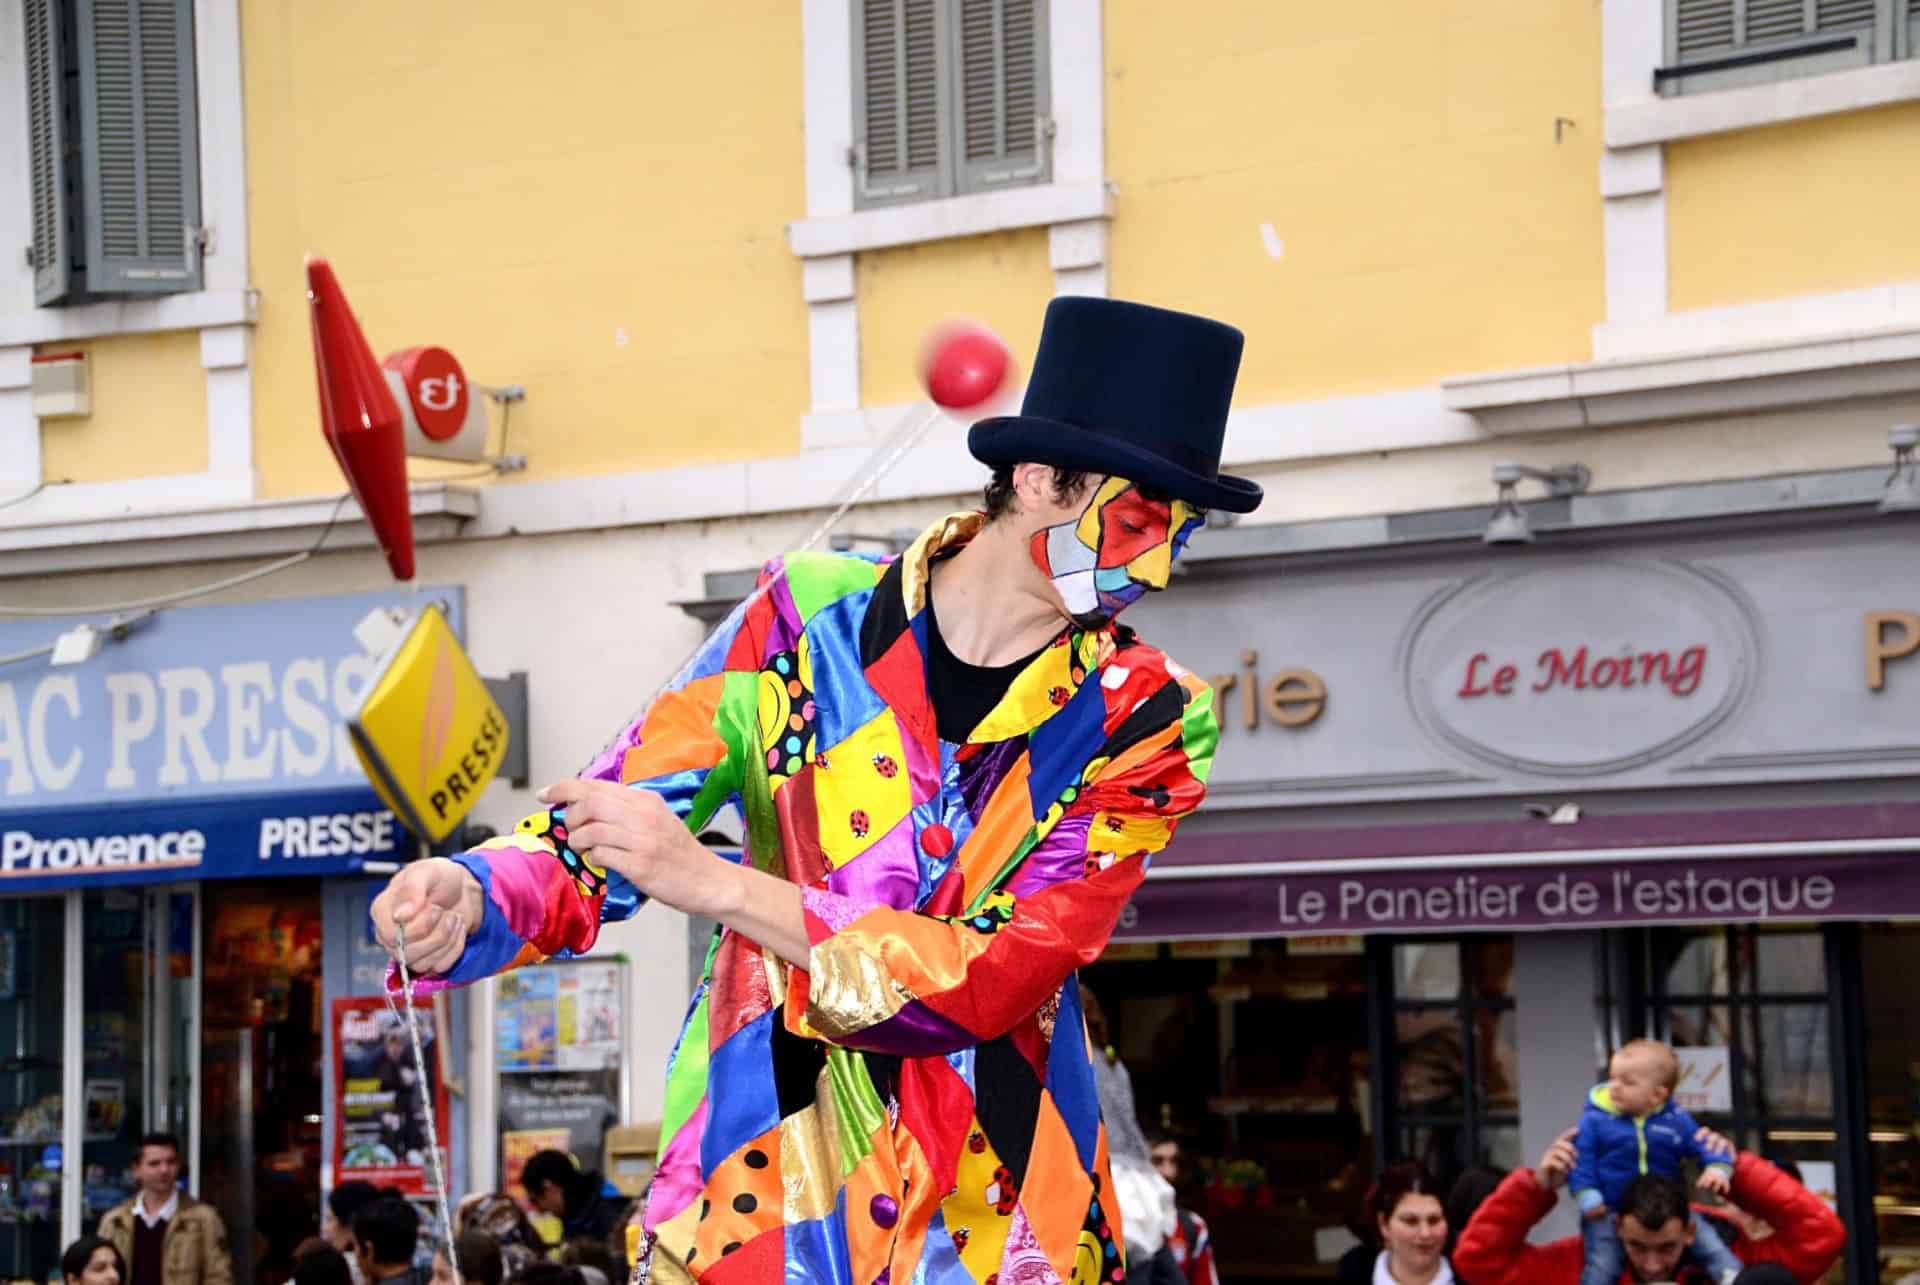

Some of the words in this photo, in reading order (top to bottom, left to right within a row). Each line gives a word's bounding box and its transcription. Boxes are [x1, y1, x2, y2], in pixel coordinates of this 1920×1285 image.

[1458, 653, 1518, 697] Le
[1532, 643, 1707, 695] Moing
[429, 708, 503, 821] PRESSE
[1, 829, 206, 871] Provence
[259, 810, 395, 859] PRESSE
[1279, 884, 1326, 924] Le
[1339, 874, 1523, 922] Panetier
[1536, 871, 1600, 916] de
[1612, 868, 1835, 919] l'estaque
